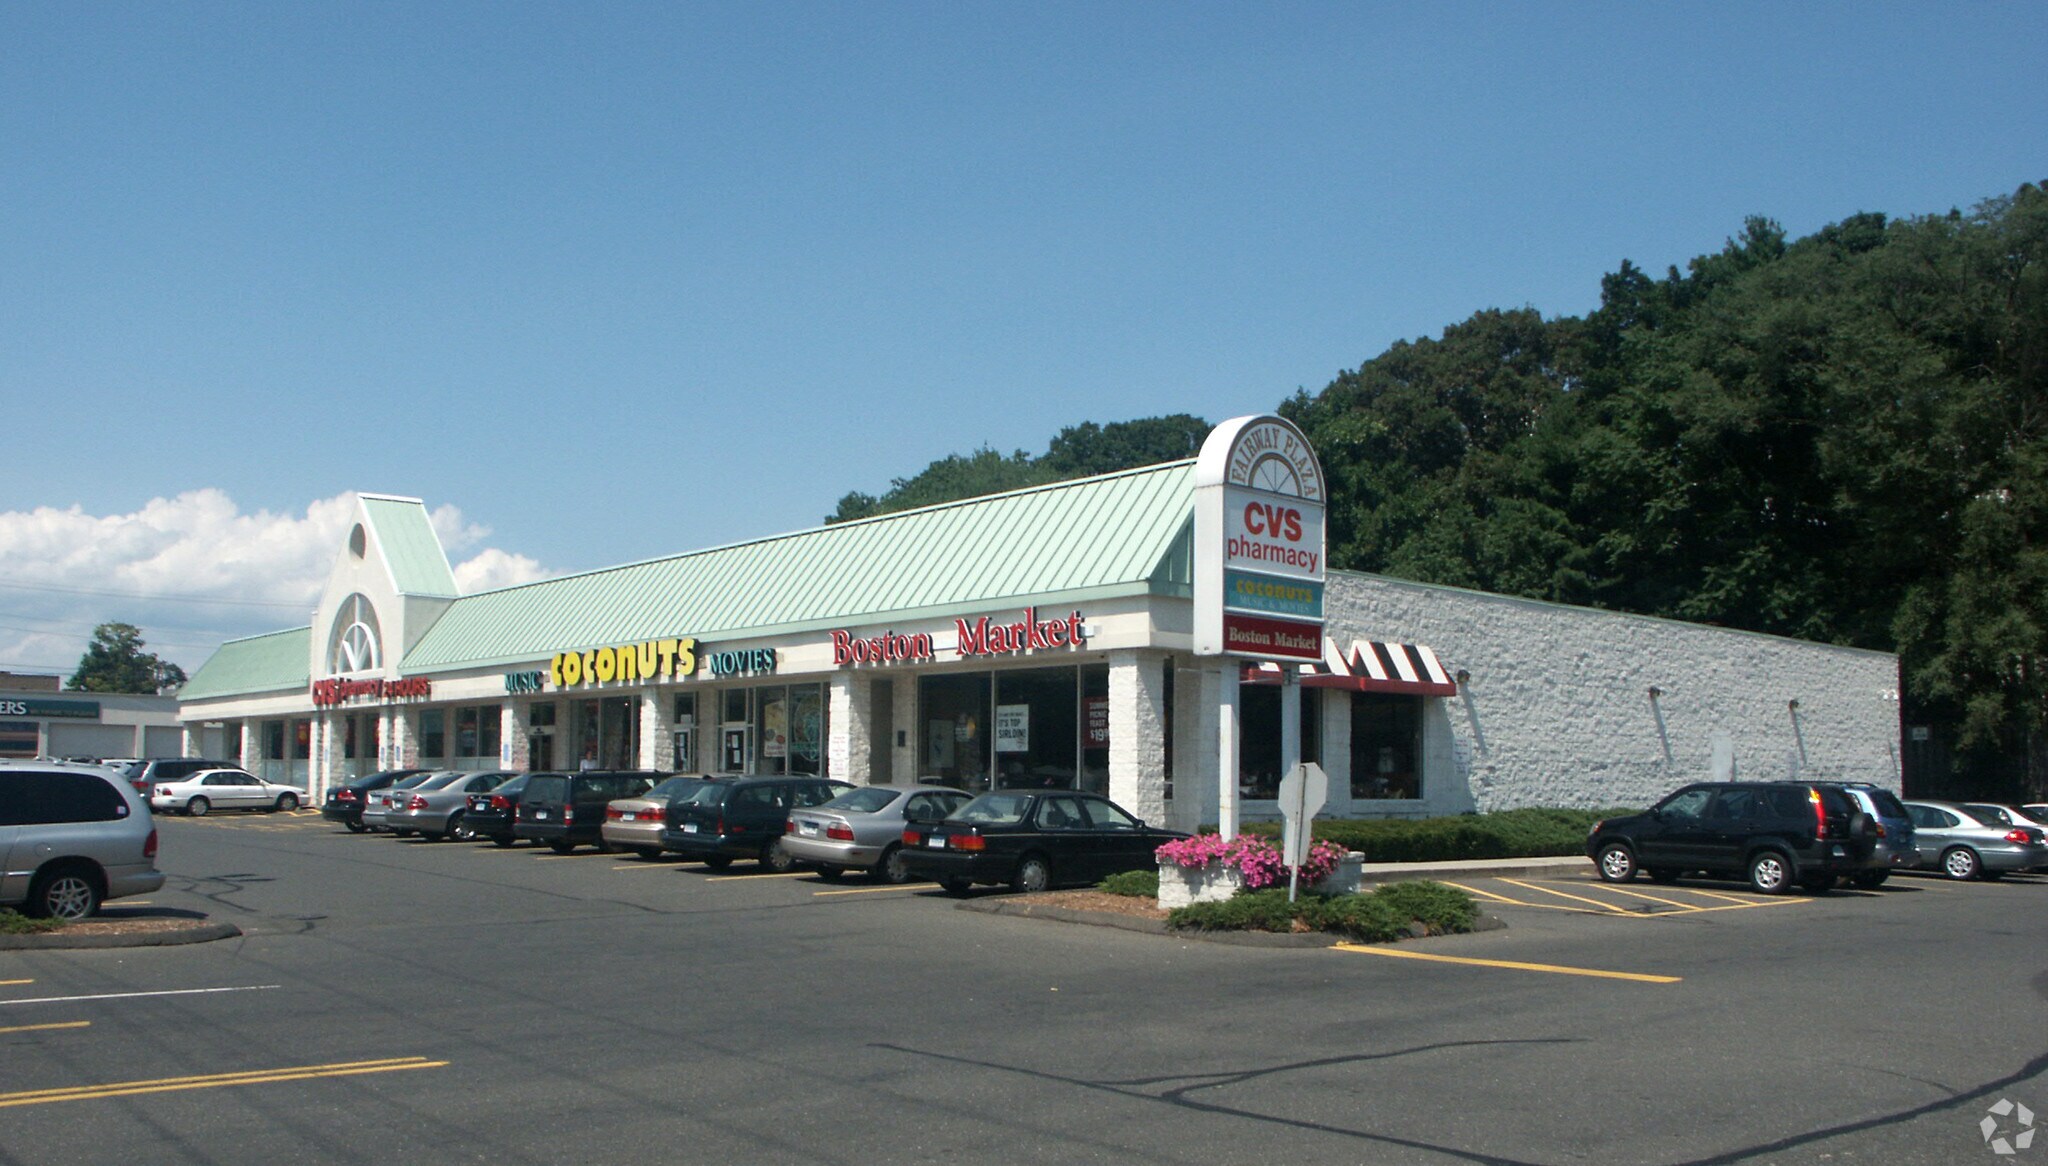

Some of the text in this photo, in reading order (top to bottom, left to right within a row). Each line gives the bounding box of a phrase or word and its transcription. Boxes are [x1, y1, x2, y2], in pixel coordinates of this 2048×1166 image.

[1232, 427, 1317, 497] FAIRWAY PLAZA
[1244, 501, 1303, 542] CVS
[1228, 534, 1318, 573] pharmacy
[1236, 580, 1313, 603] COCONUTS
[829, 606, 1084, 665] Boston Market
[1229, 626, 1317, 650] Boston Market
[504, 638, 777, 692] MUSIC COCONUTS MOVIES
[312, 679, 339, 705] CVS
